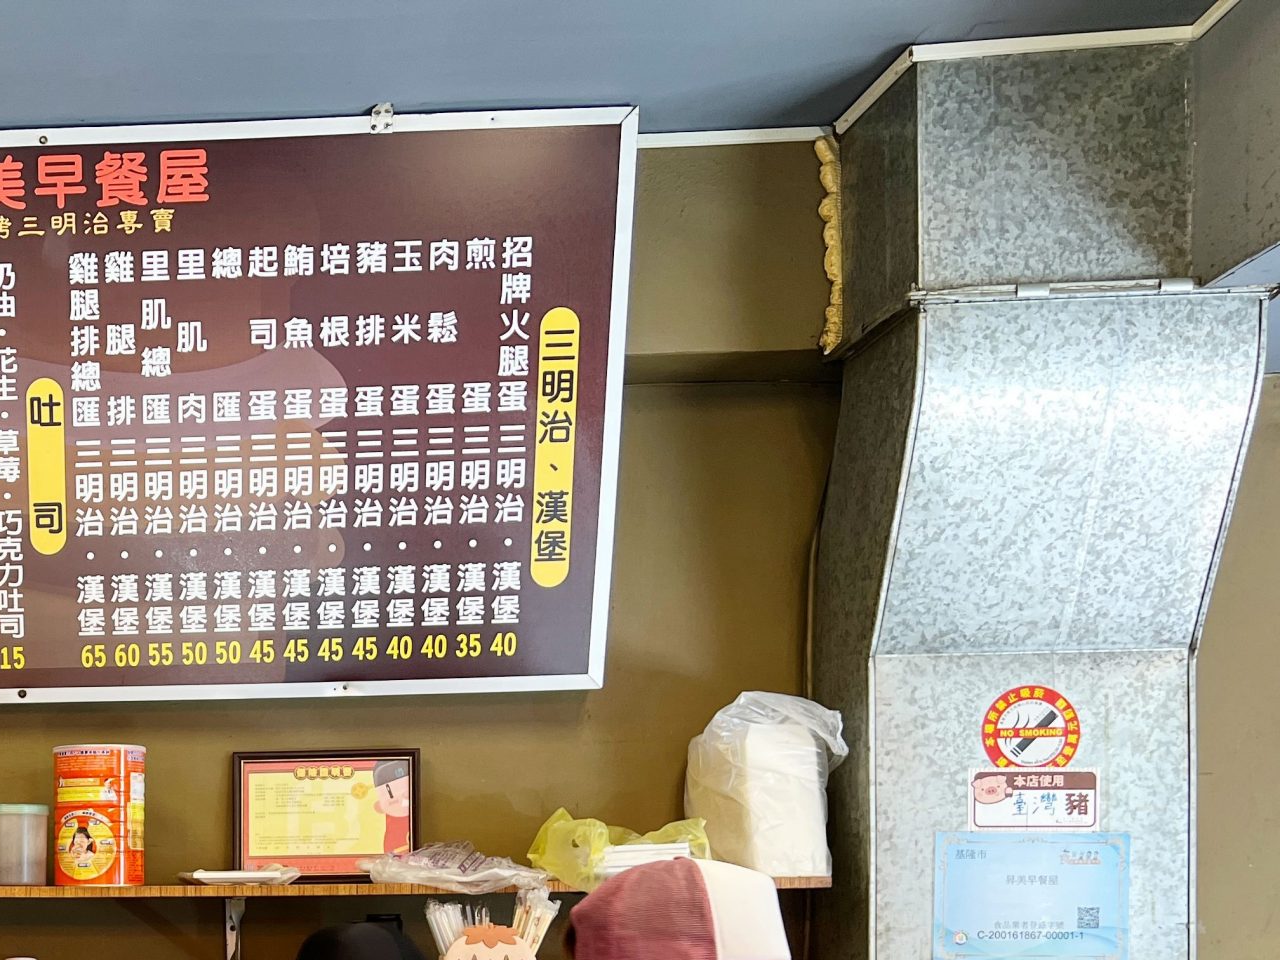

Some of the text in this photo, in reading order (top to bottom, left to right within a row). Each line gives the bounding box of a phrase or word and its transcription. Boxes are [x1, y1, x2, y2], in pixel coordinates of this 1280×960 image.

[80, 644, 107, 668] 65
[114, 643, 140, 668] 60
[148, 642, 174, 666] 55
[181, 642, 208, 666] 50
[215, 641, 242, 665] 50
[249, 640, 276, 664] 45
[283, 639, 310, 663] 45
[317, 638, 344, 662] 45
[352, 637, 378, 661] 45
[386, 636, 413, 660] 40
[420, 635, 448, 659] 40
[456, 634, 482, 658] 35
[490, 632, 517, 656] 40
[0, 646, 25, 670] 15
[1019, 728, 1063, 737] SMOKING
[1014, 774, 1064, 788] 本店使用
[955, 849, 987, 860] 基隆市
[977, 930, 1084, 940] C-200161867-00001-1
